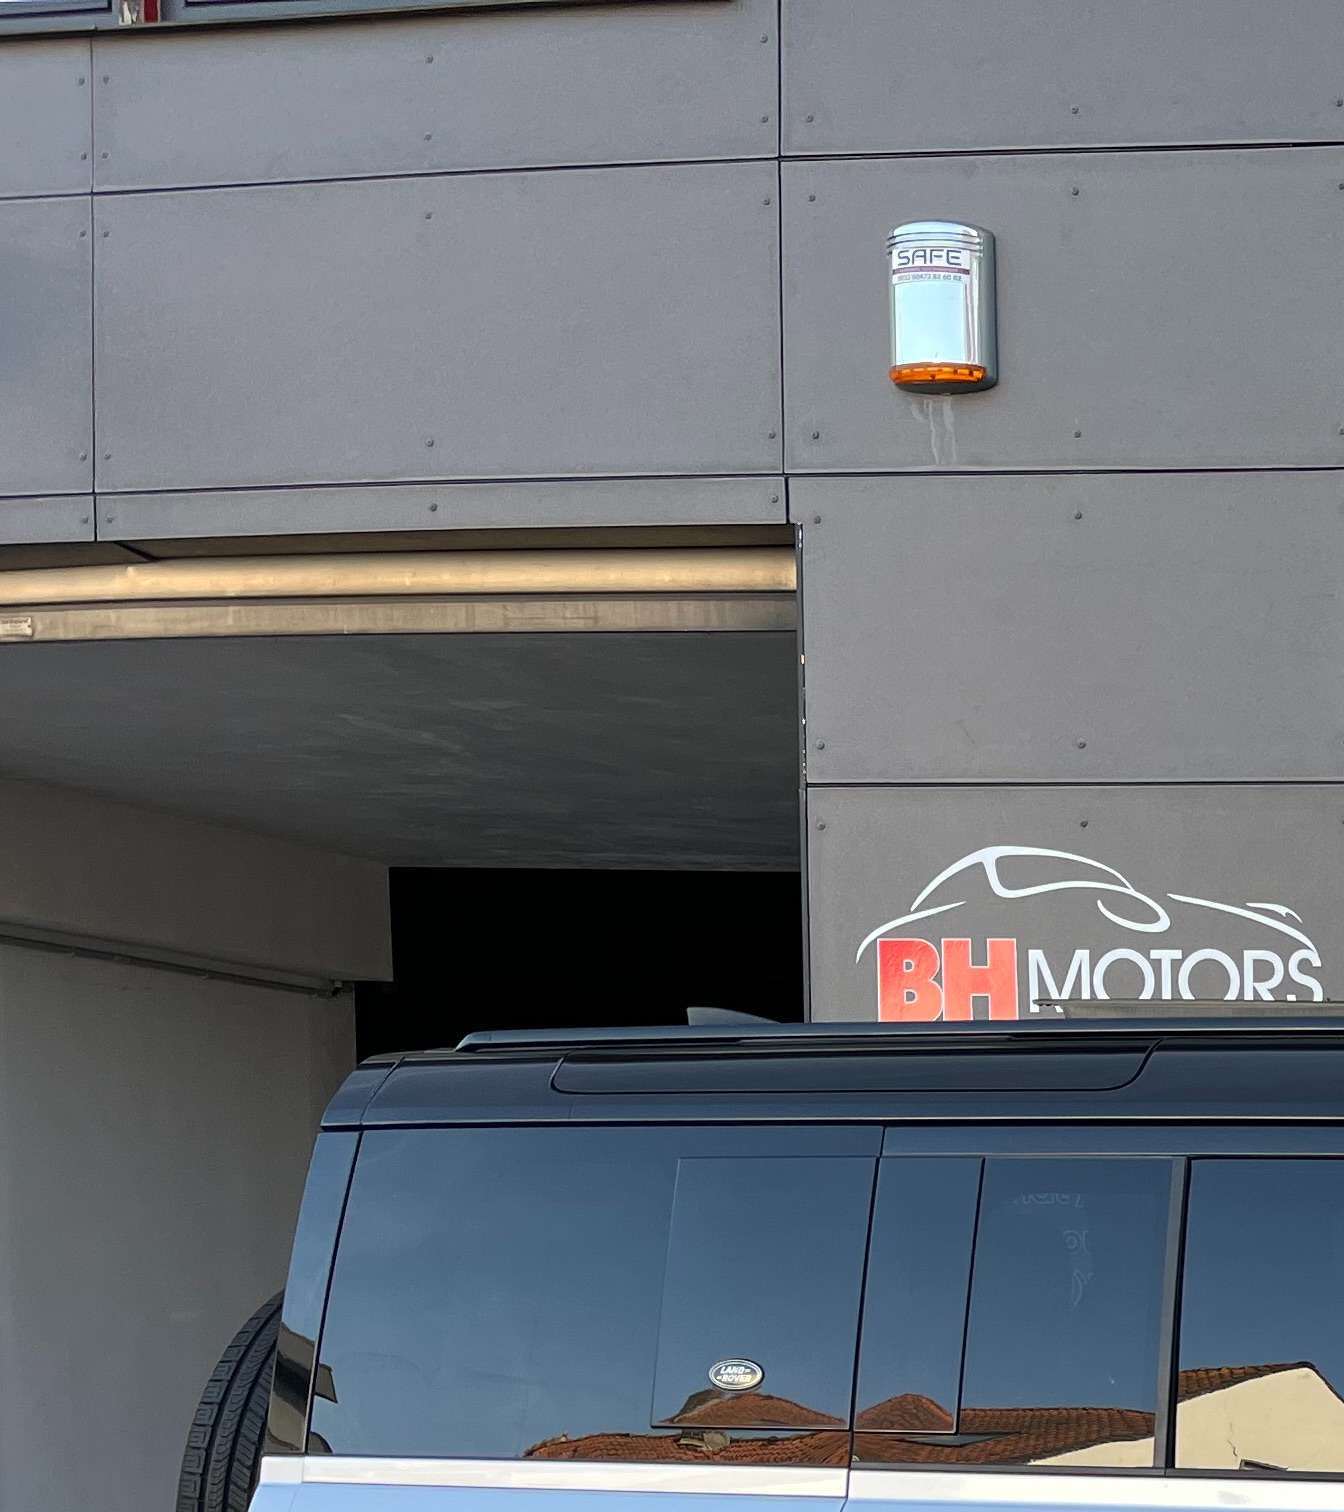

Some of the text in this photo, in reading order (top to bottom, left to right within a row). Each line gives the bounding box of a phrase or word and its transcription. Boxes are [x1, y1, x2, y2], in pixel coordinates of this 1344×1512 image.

[897, 248, 962, 266] SAFE
[876, 937, 1324, 1023] BH MOTORS
